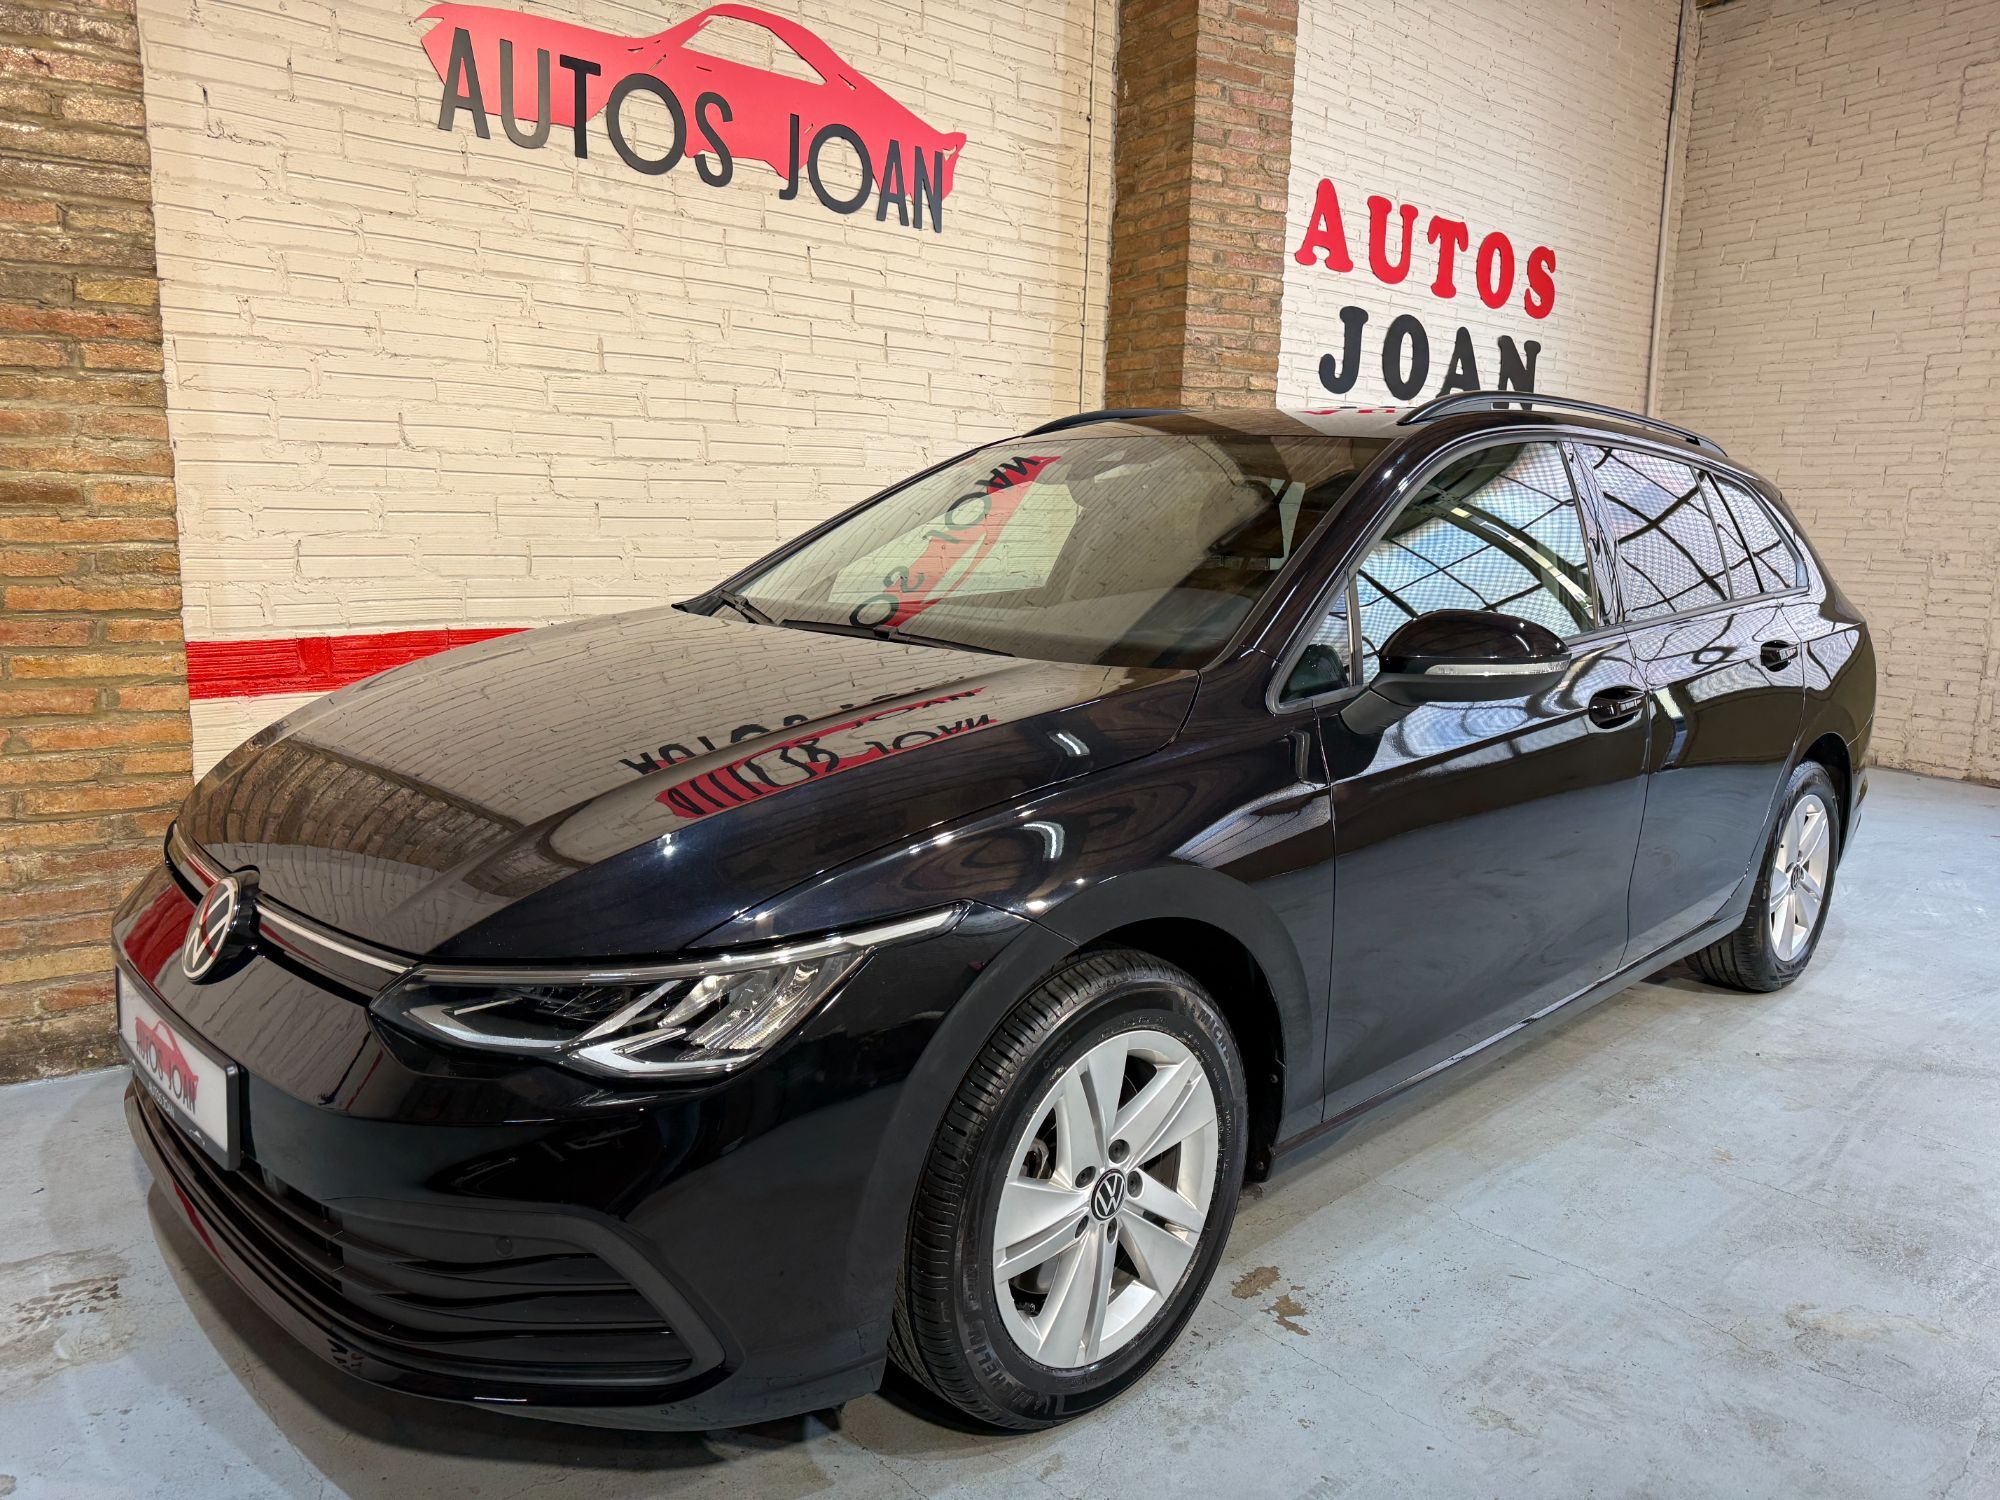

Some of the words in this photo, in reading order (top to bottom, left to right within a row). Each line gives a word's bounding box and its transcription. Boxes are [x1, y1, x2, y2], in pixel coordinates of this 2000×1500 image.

[438, 27, 734, 187] AUTOS
[779, 113, 943, 233] JOAN
[1295, 178, 1556, 319] AUTOS
[1319, 306, 1541, 410] JOAN
[167, 1058, 197, 1115] JOAN
